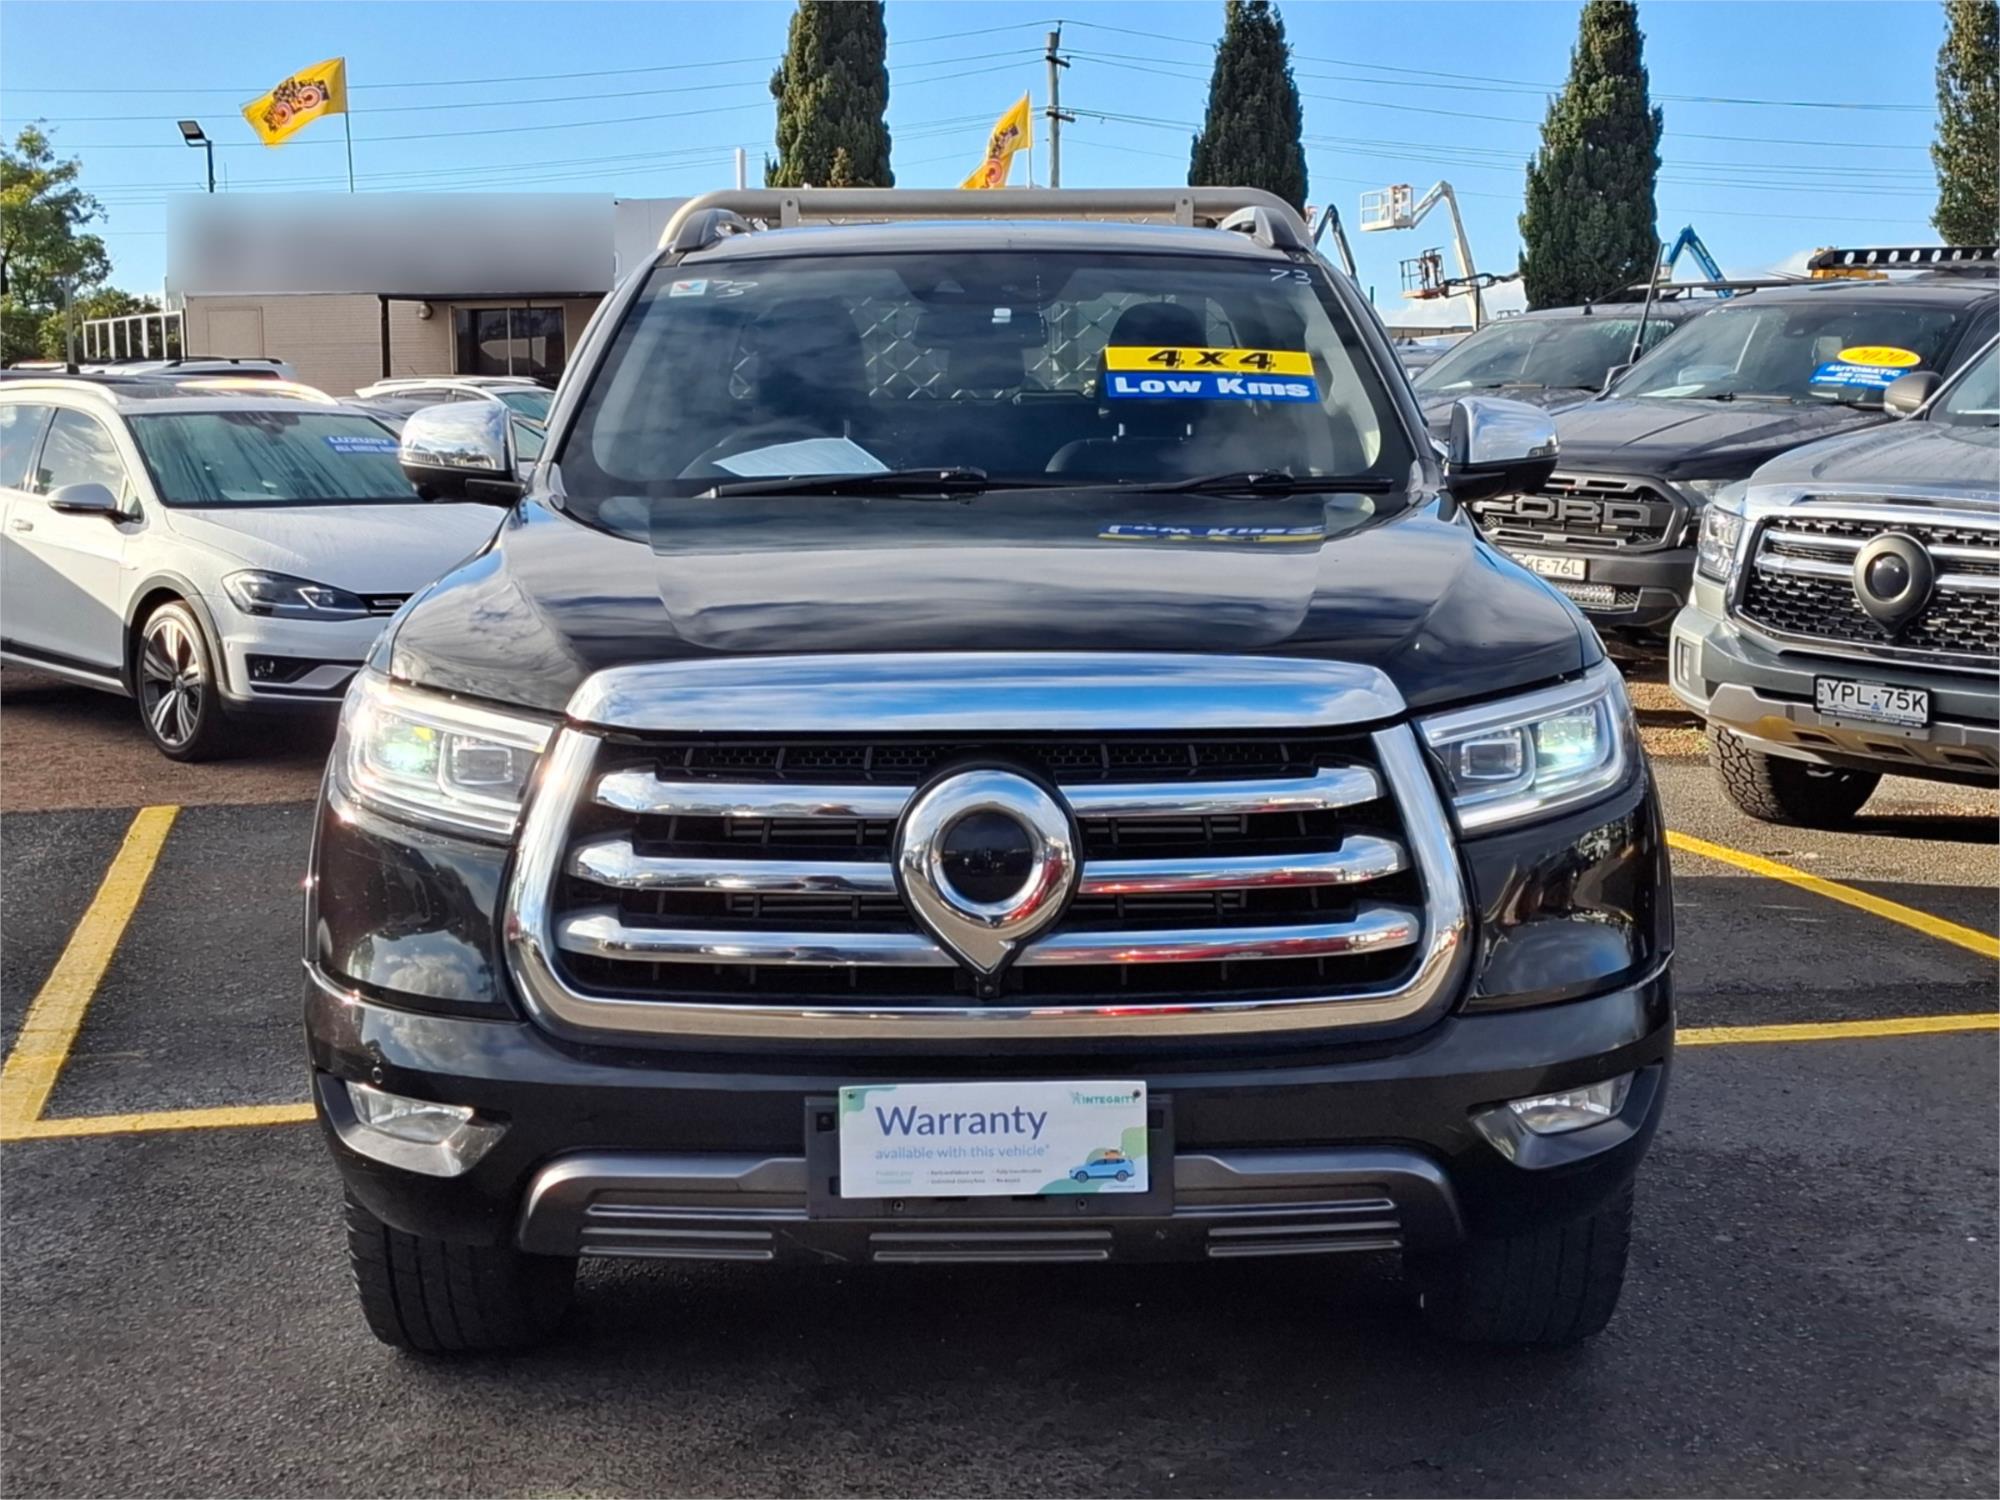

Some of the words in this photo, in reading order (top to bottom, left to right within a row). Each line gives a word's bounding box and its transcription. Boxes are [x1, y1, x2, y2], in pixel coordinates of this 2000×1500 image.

[1269, 267, 1312, 285] 73
[1114, 376, 1202, 394] Low
[1216, 377, 1311, 398] Kms
[1473, 494, 1651, 527] FORD
[875, 1104, 1048, 1140] Warranty
[875, 1146, 933, 1160] available
[937, 1145, 966, 1158] with
[970, 1145, 994, 1158] this
